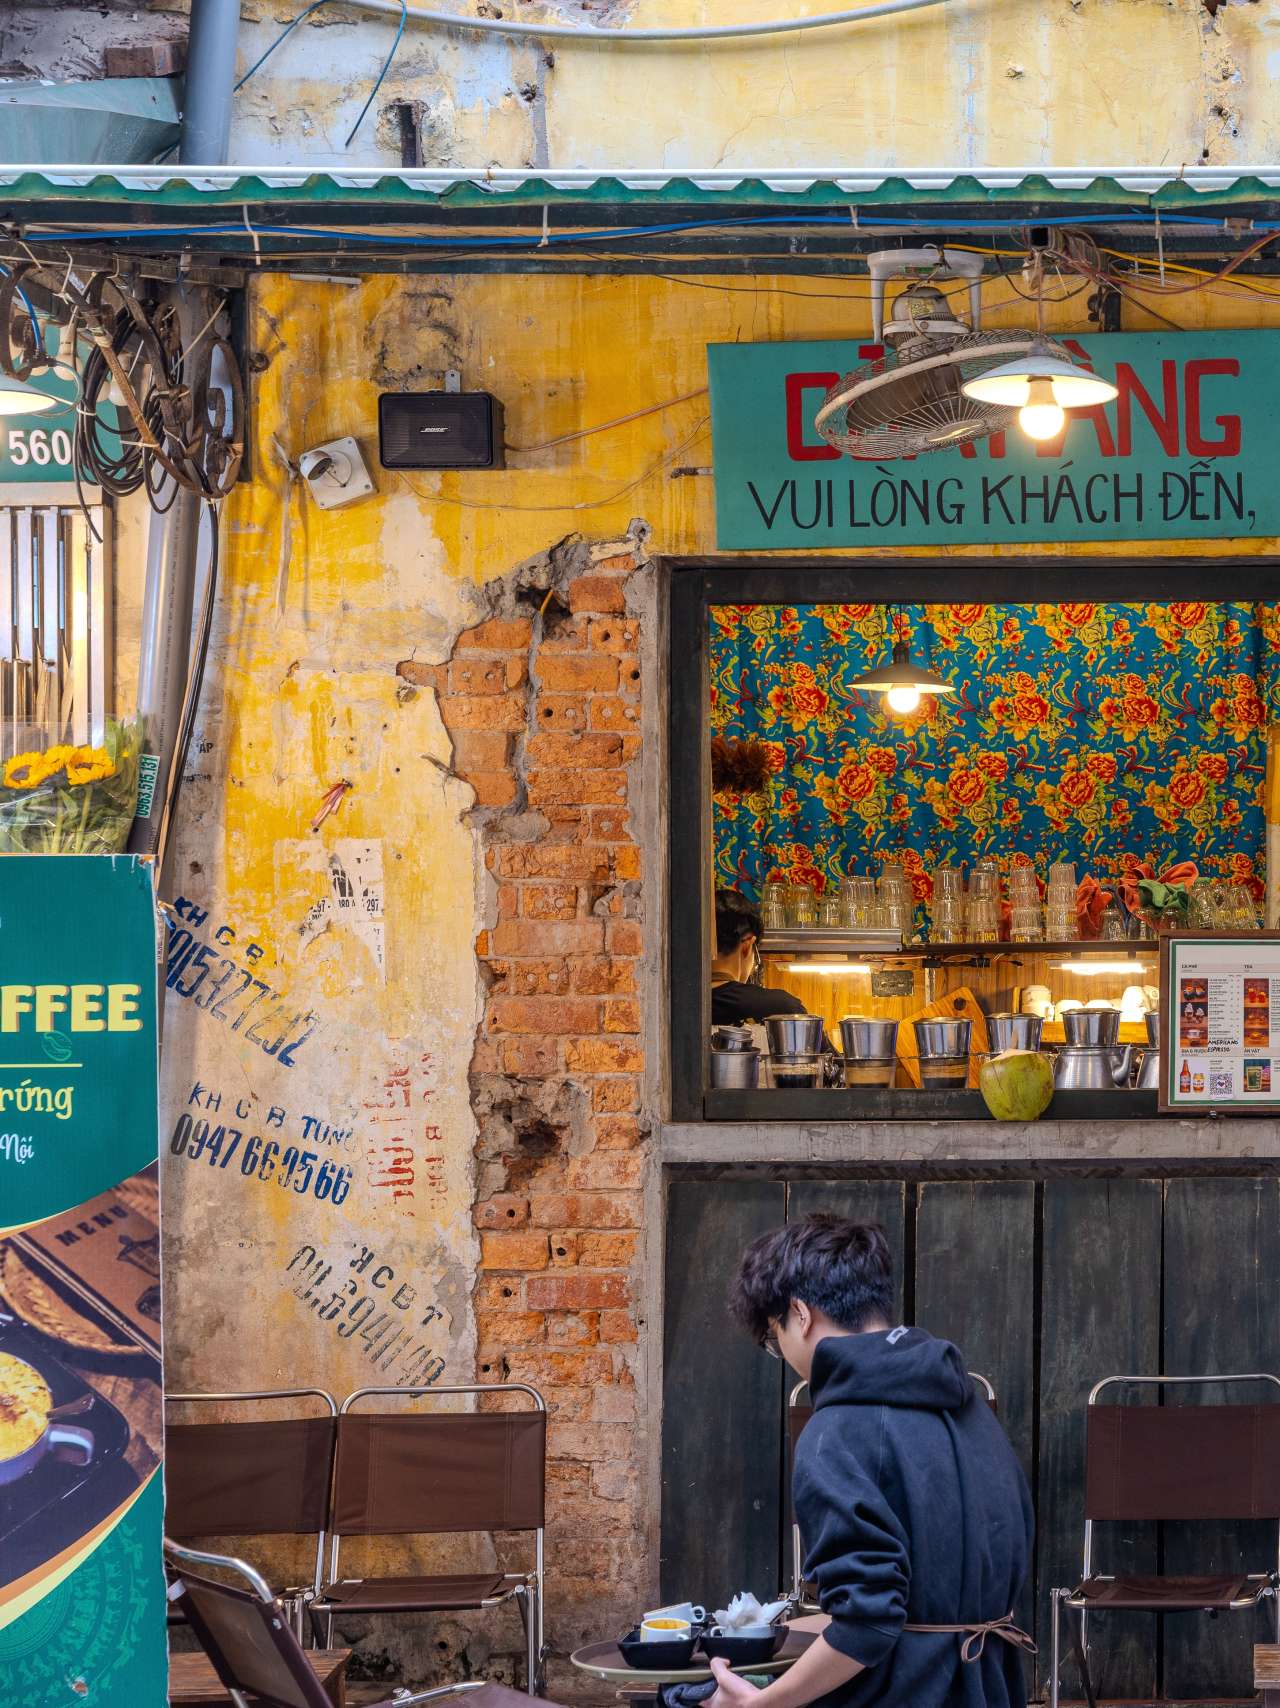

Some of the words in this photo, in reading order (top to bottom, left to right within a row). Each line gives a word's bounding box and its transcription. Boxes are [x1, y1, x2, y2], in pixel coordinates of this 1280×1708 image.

[8, 429, 72, 466] 560
[747, 478, 834, 530] VUI
[847, 465, 965, 529] LÒNG
[983, 460, 1144, 525] KHÁCH
[136, 756, 158, 817] 0963.515.131
[54, 1204, 130, 1247] MENU
